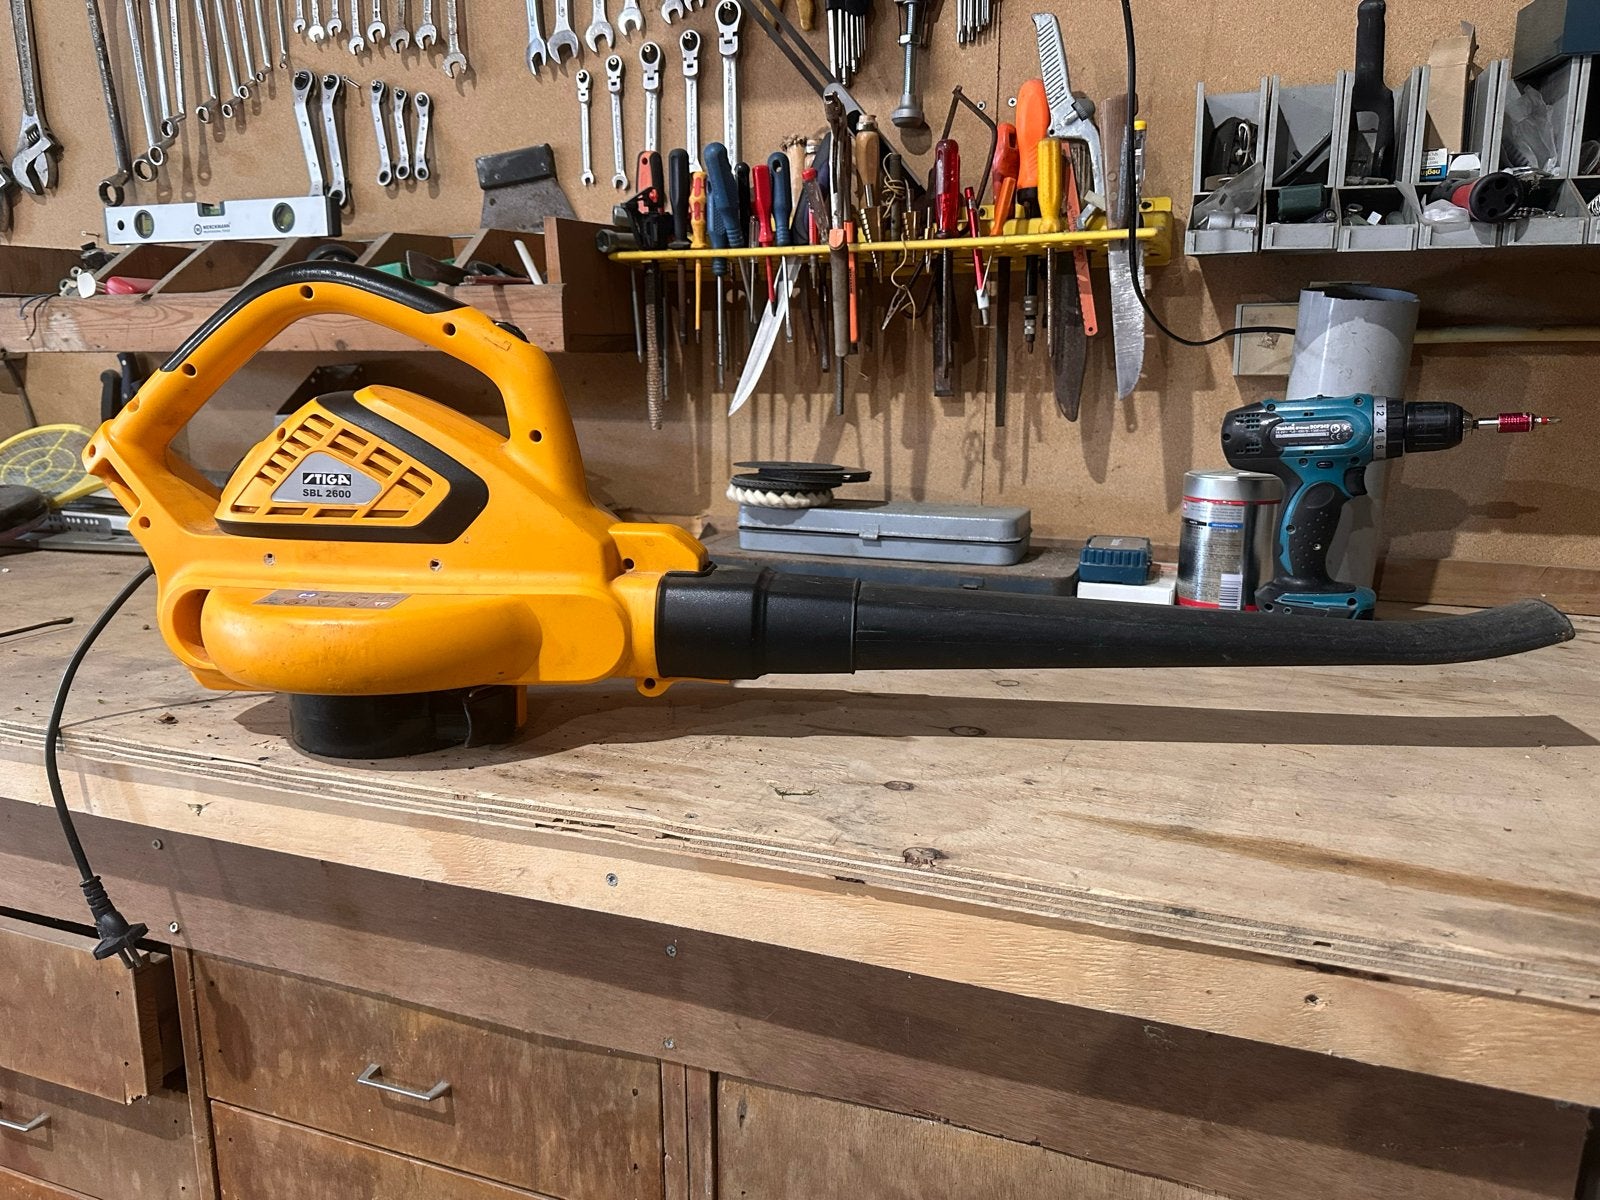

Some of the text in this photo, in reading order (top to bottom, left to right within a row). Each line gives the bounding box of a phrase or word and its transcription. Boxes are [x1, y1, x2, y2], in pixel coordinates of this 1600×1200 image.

[303, 473, 351, 485] STIGA
[303, 489, 351, 498] SBL 2600
